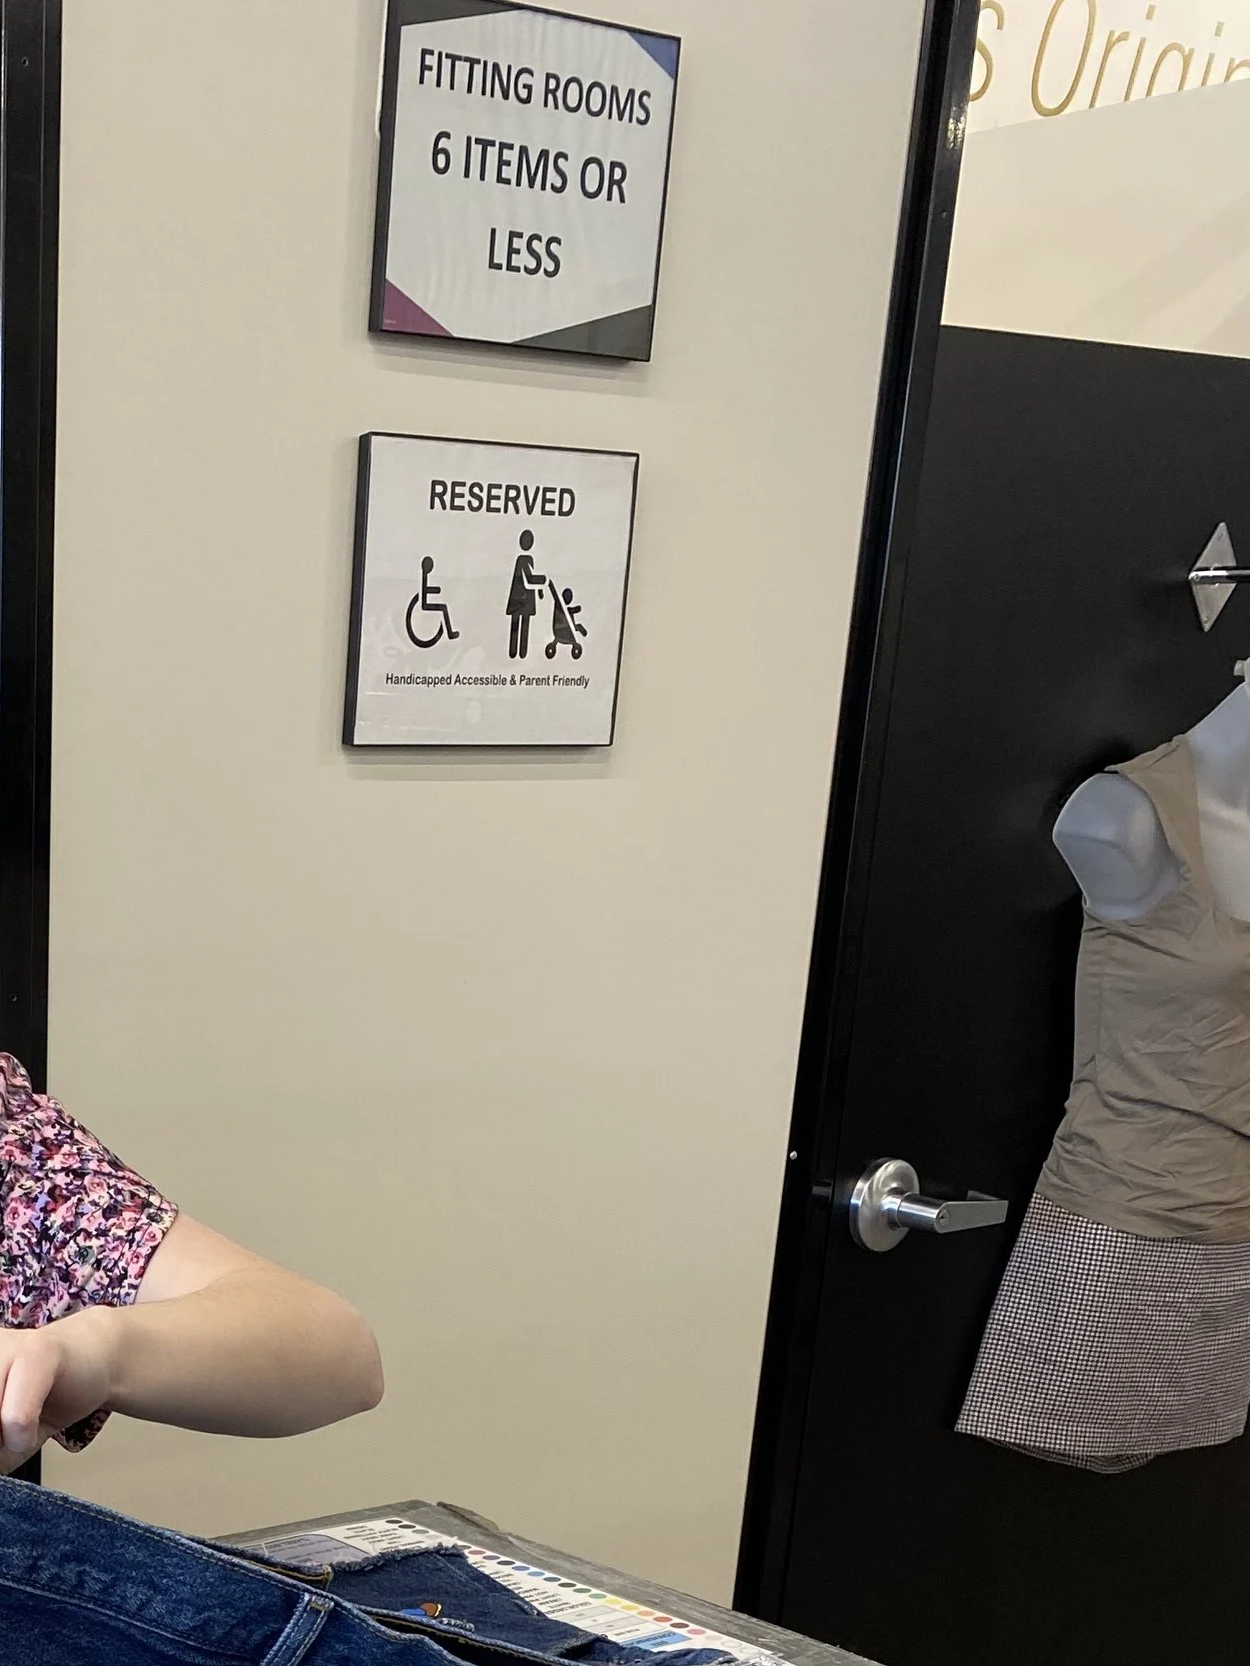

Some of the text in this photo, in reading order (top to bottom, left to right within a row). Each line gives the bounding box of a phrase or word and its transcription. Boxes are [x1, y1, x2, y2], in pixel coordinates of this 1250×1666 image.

[418, 47, 652, 126] FITTING ROOMS
[431, 130, 628, 204] 6 ITEMS OR
[488, 227, 562, 278] LESS
[429, 480, 575, 517] RESERVED
[385, 672, 590, 689] Handicapped Accessible & Parent Friendly
